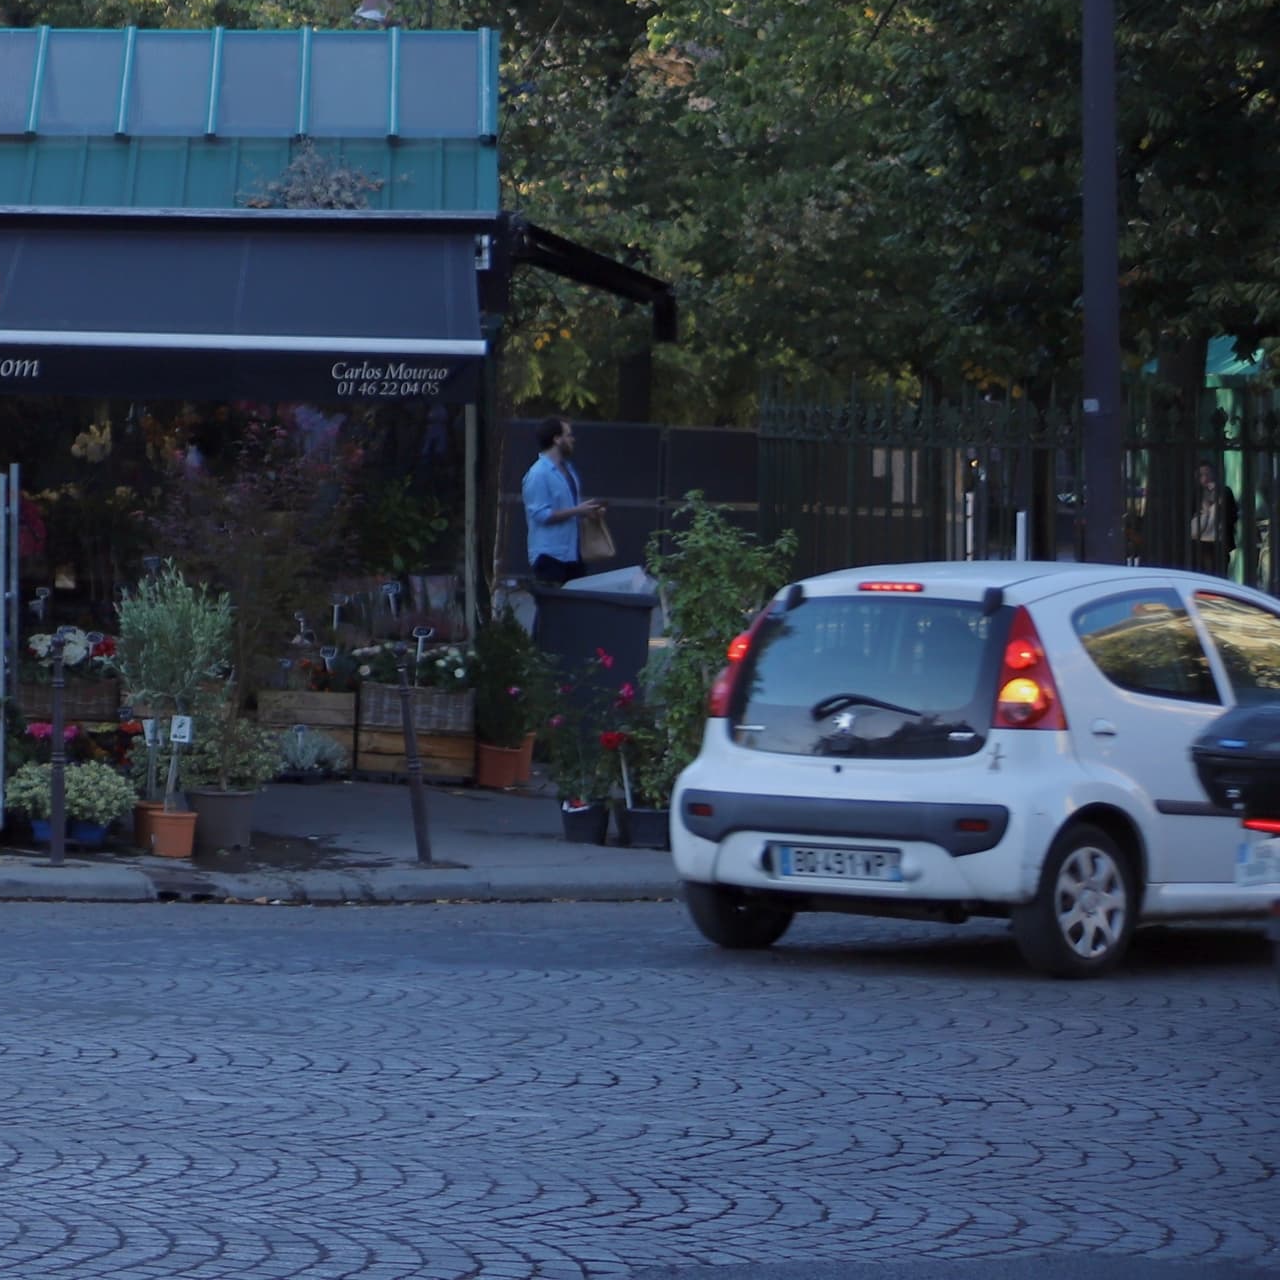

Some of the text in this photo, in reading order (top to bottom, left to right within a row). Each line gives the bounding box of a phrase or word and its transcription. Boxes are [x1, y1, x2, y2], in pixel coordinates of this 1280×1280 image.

[331, 361, 448, 380] Carlos Mourao
[337, 381, 440, 396] 01 46 22 04 05
